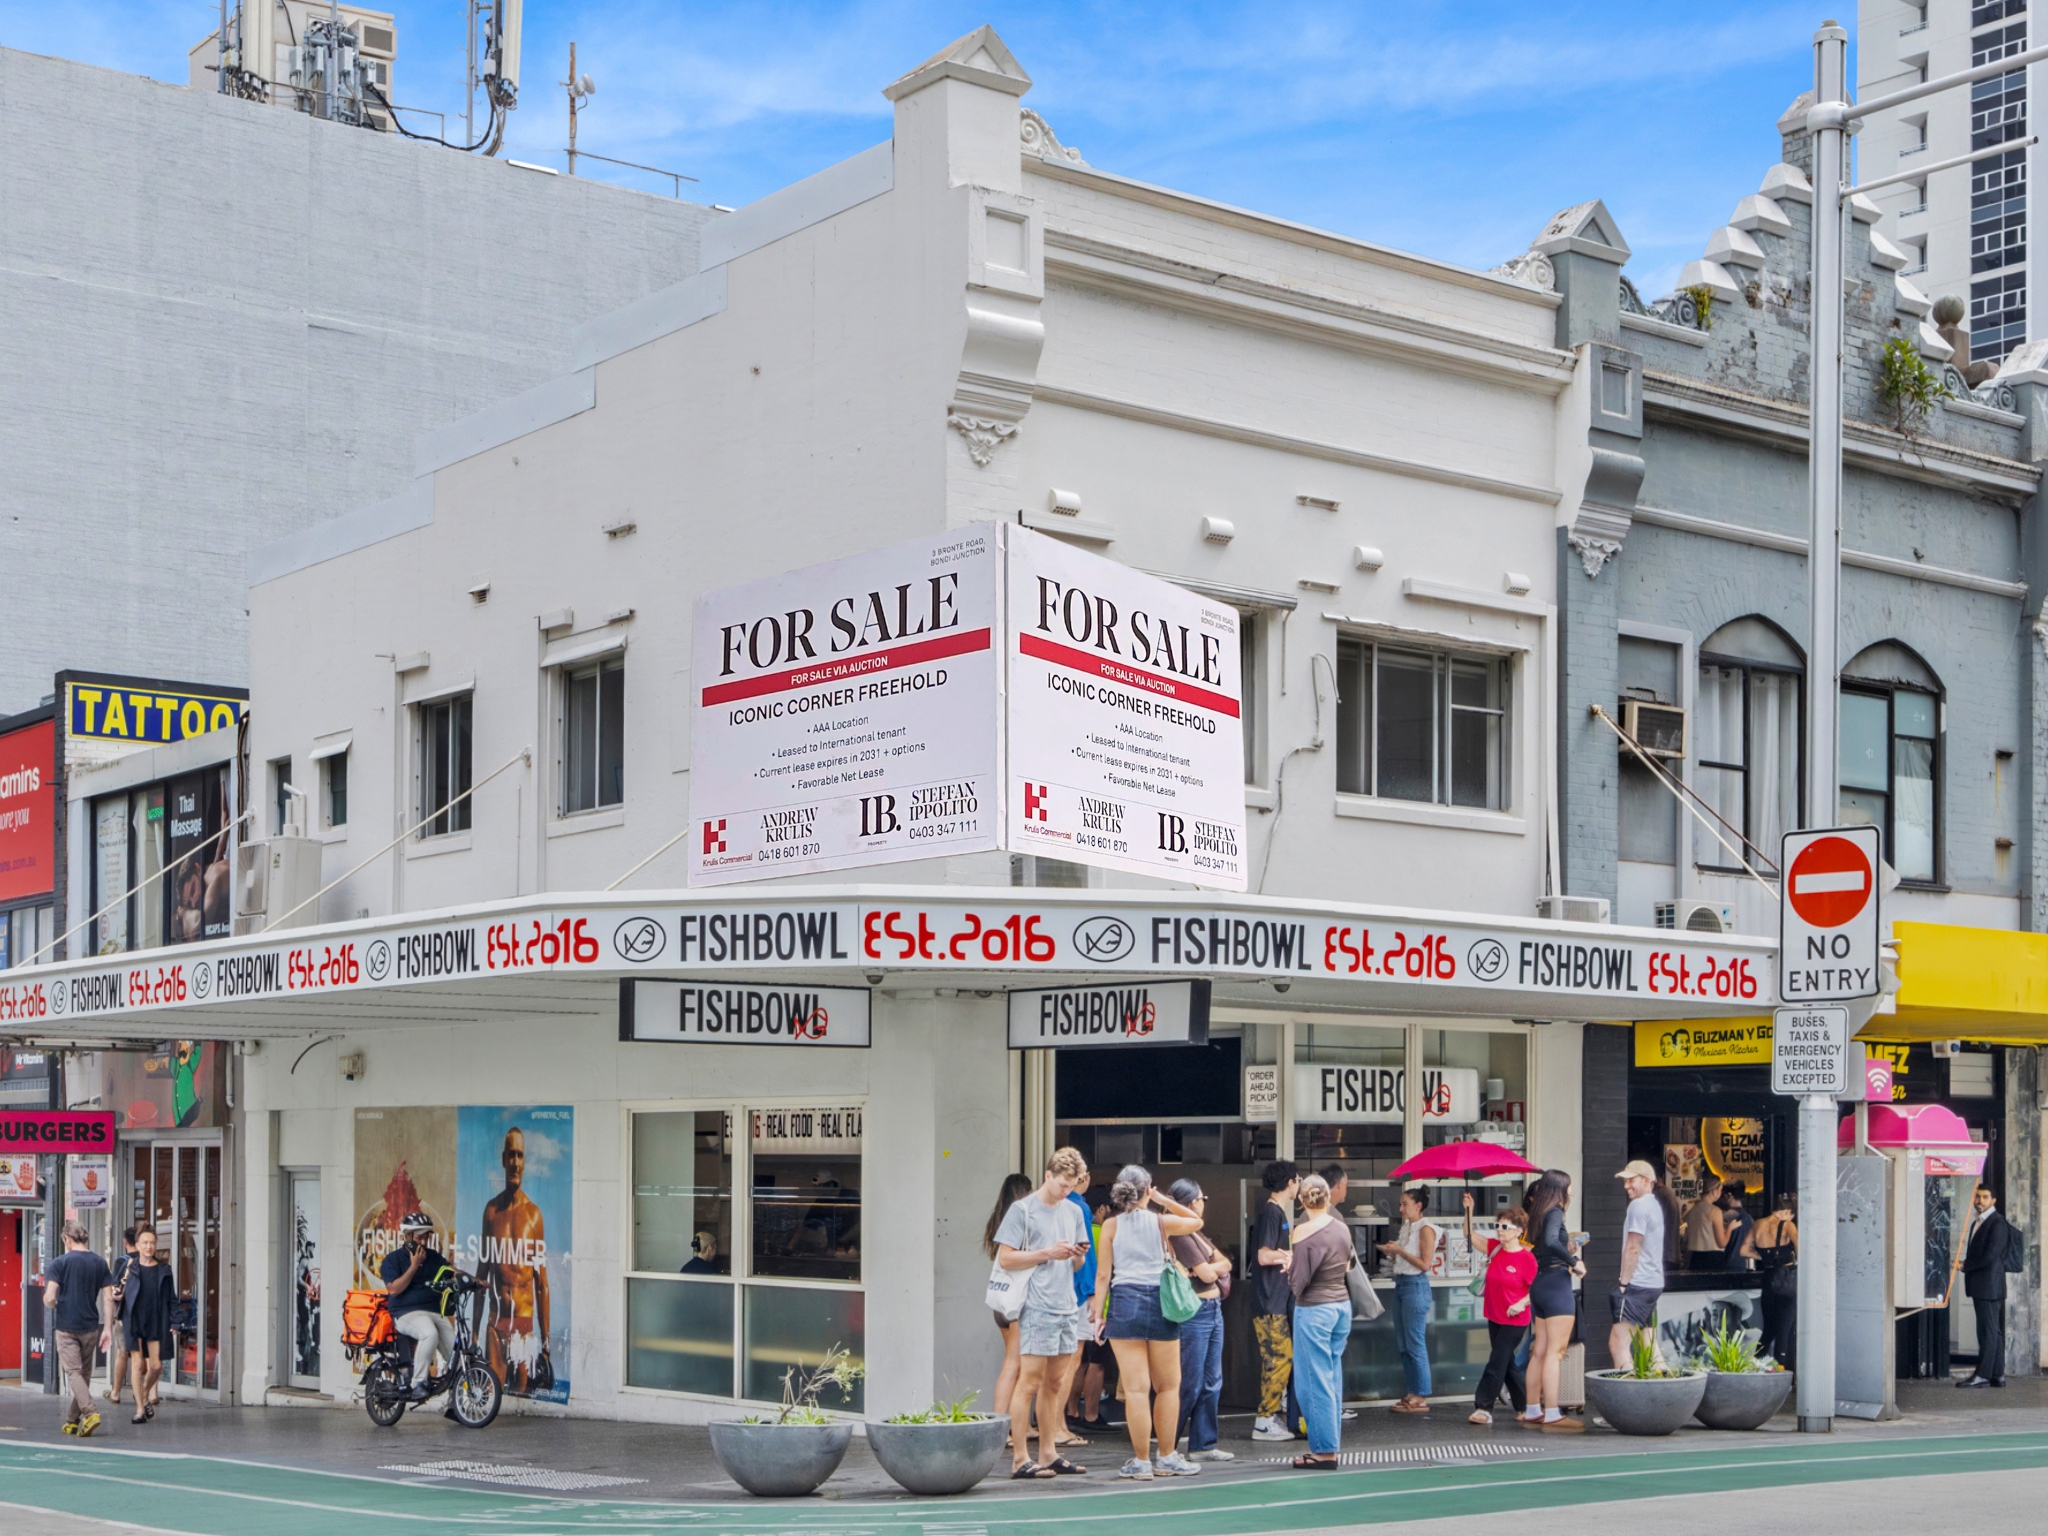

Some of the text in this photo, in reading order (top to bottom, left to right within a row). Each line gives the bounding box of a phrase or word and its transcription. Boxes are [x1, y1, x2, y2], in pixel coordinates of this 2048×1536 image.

[930, 546, 986, 566] BONDI JUNCTION
[938, 543, 964, 556] BRONTE
[719, 572, 958, 676] FOR SALE
[1036, 575, 1221, 686] FOR SALE
[791, 655, 888, 685] FOR SALE VIA AUCTION
[1101, 664, 1175, 694] FOR SALE VIA AUCTION
[729, 669, 948, 726] ICONIC CORNER FREEHOLD
[1048, 672, 1216, 734] ICONIC CORNER FREEHOLD
[78, 689, 235, 741] TATTOO
[813, 715, 869, 735] AAA Location
[777, 727, 906, 758] Leased to International tenant
[1119, 723, 1163, 743] AAA Location
[759, 763, 791, 778] Current
[793, 760, 815, 773] lease
[817, 755, 848, 774] expires
[849, 752, 858, 763] in
[860, 749, 881, 762] 2031
[891, 741, 925, 759] options
[1091, 733, 1191, 767] Leased to International tenant
[798, 767, 884, 790] Favorable Net Lease
[1076, 747, 1103, 763] Current
[1104, 753, 1122, 768] lease
[1123, 761, 1148, 774] expires
[1150, 765, 1156, 774] in
[1157, 767, 1173, 780] 2031
[1180, 773, 1204, 788] options
[911, 782, 975, 805] STEFFAN
[1109, 773, 1176, 797] Favorable Net Lease
[179, 794, 195, 814] Thai
[909, 798, 978, 822] IPPOLITO
[1078, 797, 1126, 819] ANDREW
[13, 807, 30, 833] you
[171, 818, 202, 838] Massage
[760, 807, 818, 829] ANDREW
[1082, 813, 1122, 834] KRULIS
[765, 823, 813, 843] KRULIS
[909, 819, 977, 840] 0403 347 111
[1195, 821, 1235, 842] STEFFAN
[758, 843, 820, 862] 0418 601 870
[1076, 832, 1128, 852] 0418 601 870
[1193, 834, 1237, 857] IPPOLITO
[703, 853, 752, 867] Krulis Commercial
[1193, 855, 1211, 867] 0403
[1212, 858, 1225, 870] 347
[1226, 861, 1238, 873] 111
[1151, 916, 1312, 971] FISHBOWL
[1518, 941, 1638, 992] FISHBOWL
[1807, 934, 1850, 960] NO
[71, 973, 125, 1013] FISHBOWL
[216, 952, 283, 997] FISHBOWL
[397, 928, 480, 979] FISHBOWL
[680, 911, 848, 962] FISHBOWL
[1789, 968, 1870, 992] ENTRY
[679, 988, 827, 1037] FISHBOWL
[1040, 988, 1154, 1037] FISHBOWL
[1792, 1016, 1828, 1028] BUSES,
[1693, 1028, 1744, 1045] GUZMAN
[1746, 1028, 1755, 1041] Y
[1789, 1030, 1830, 1042] TAXIS &
[1694, 1044, 1759, 1058] Mexican Kitchen
[1778, 1045, 1842, 1056] EMERGENCY
[1785, 1059, 1834, 1070] VEHICLES
[1250, 1082, 1274, 1092] AHEAD
[1782, 1074, 1836, 1084] EXCEPTED
[1250, 1094, 1278, 1102] PICK UP
[766, 1114, 788, 1138] REAL
[790, 1114, 812, 1138] FOOD
[821, 1113, 842, 1138] REAL
[1720, 1150, 1729, 1162] Y
[466, 1234, 548, 1268] SUMMER
